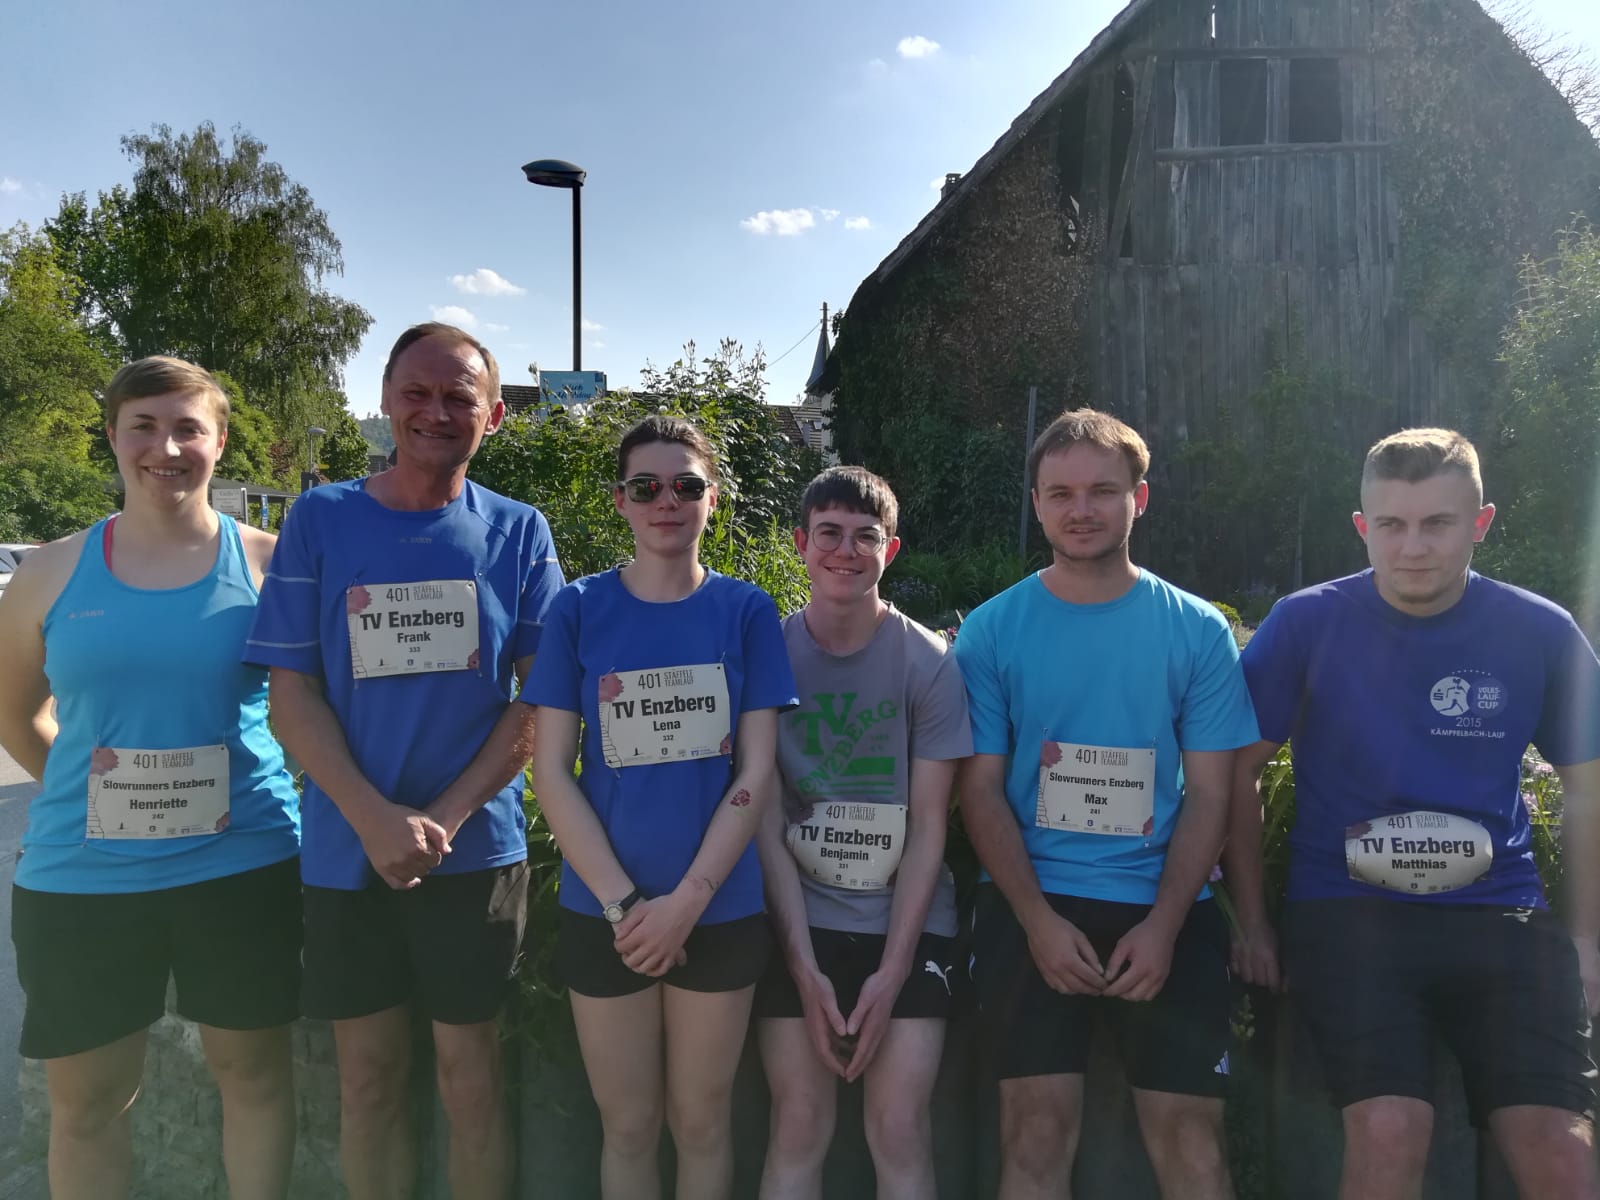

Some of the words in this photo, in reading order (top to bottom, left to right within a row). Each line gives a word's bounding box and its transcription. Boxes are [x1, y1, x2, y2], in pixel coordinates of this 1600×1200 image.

[386, 587, 411, 602] 401
[360, 613, 382, 630] TV
[388, 609, 464, 628] Enzberg
[397, 631, 431, 643] Frank
[638, 673, 662, 690] 401
[612, 701, 635, 719] TV
[640, 695, 716, 716] Enzberg
[1478, 700, 1499, 709] CUP
[653, 720, 681, 732] Lena
[792, 692, 858, 756] TV
[1455, 717, 1481, 727] 2015
[133, 753, 158, 769] 401
[1075, 748, 1097, 764] 401
[103, 779, 169, 791] Slowrunners
[173, 778, 215, 789] Enzberg
[1049, 772, 1106, 787] Slowrunners
[1109, 778, 1144, 790] Enzberg
[130, 797, 188, 810] Henriette
[1085, 793, 1108, 806] Max
[825, 805, 846, 819] 401
[1387, 815, 1412, 829] 401
[800, 825, 819, 841] TV
[823, 827, 892, 850] Enzberg
[820, 847, 869, 861] Benjamin
[1360, 838, 1384, 854] TV
[1390, 837, 1475, 858] Enzberg
[1391, 859, 1447, 869] Matthias
